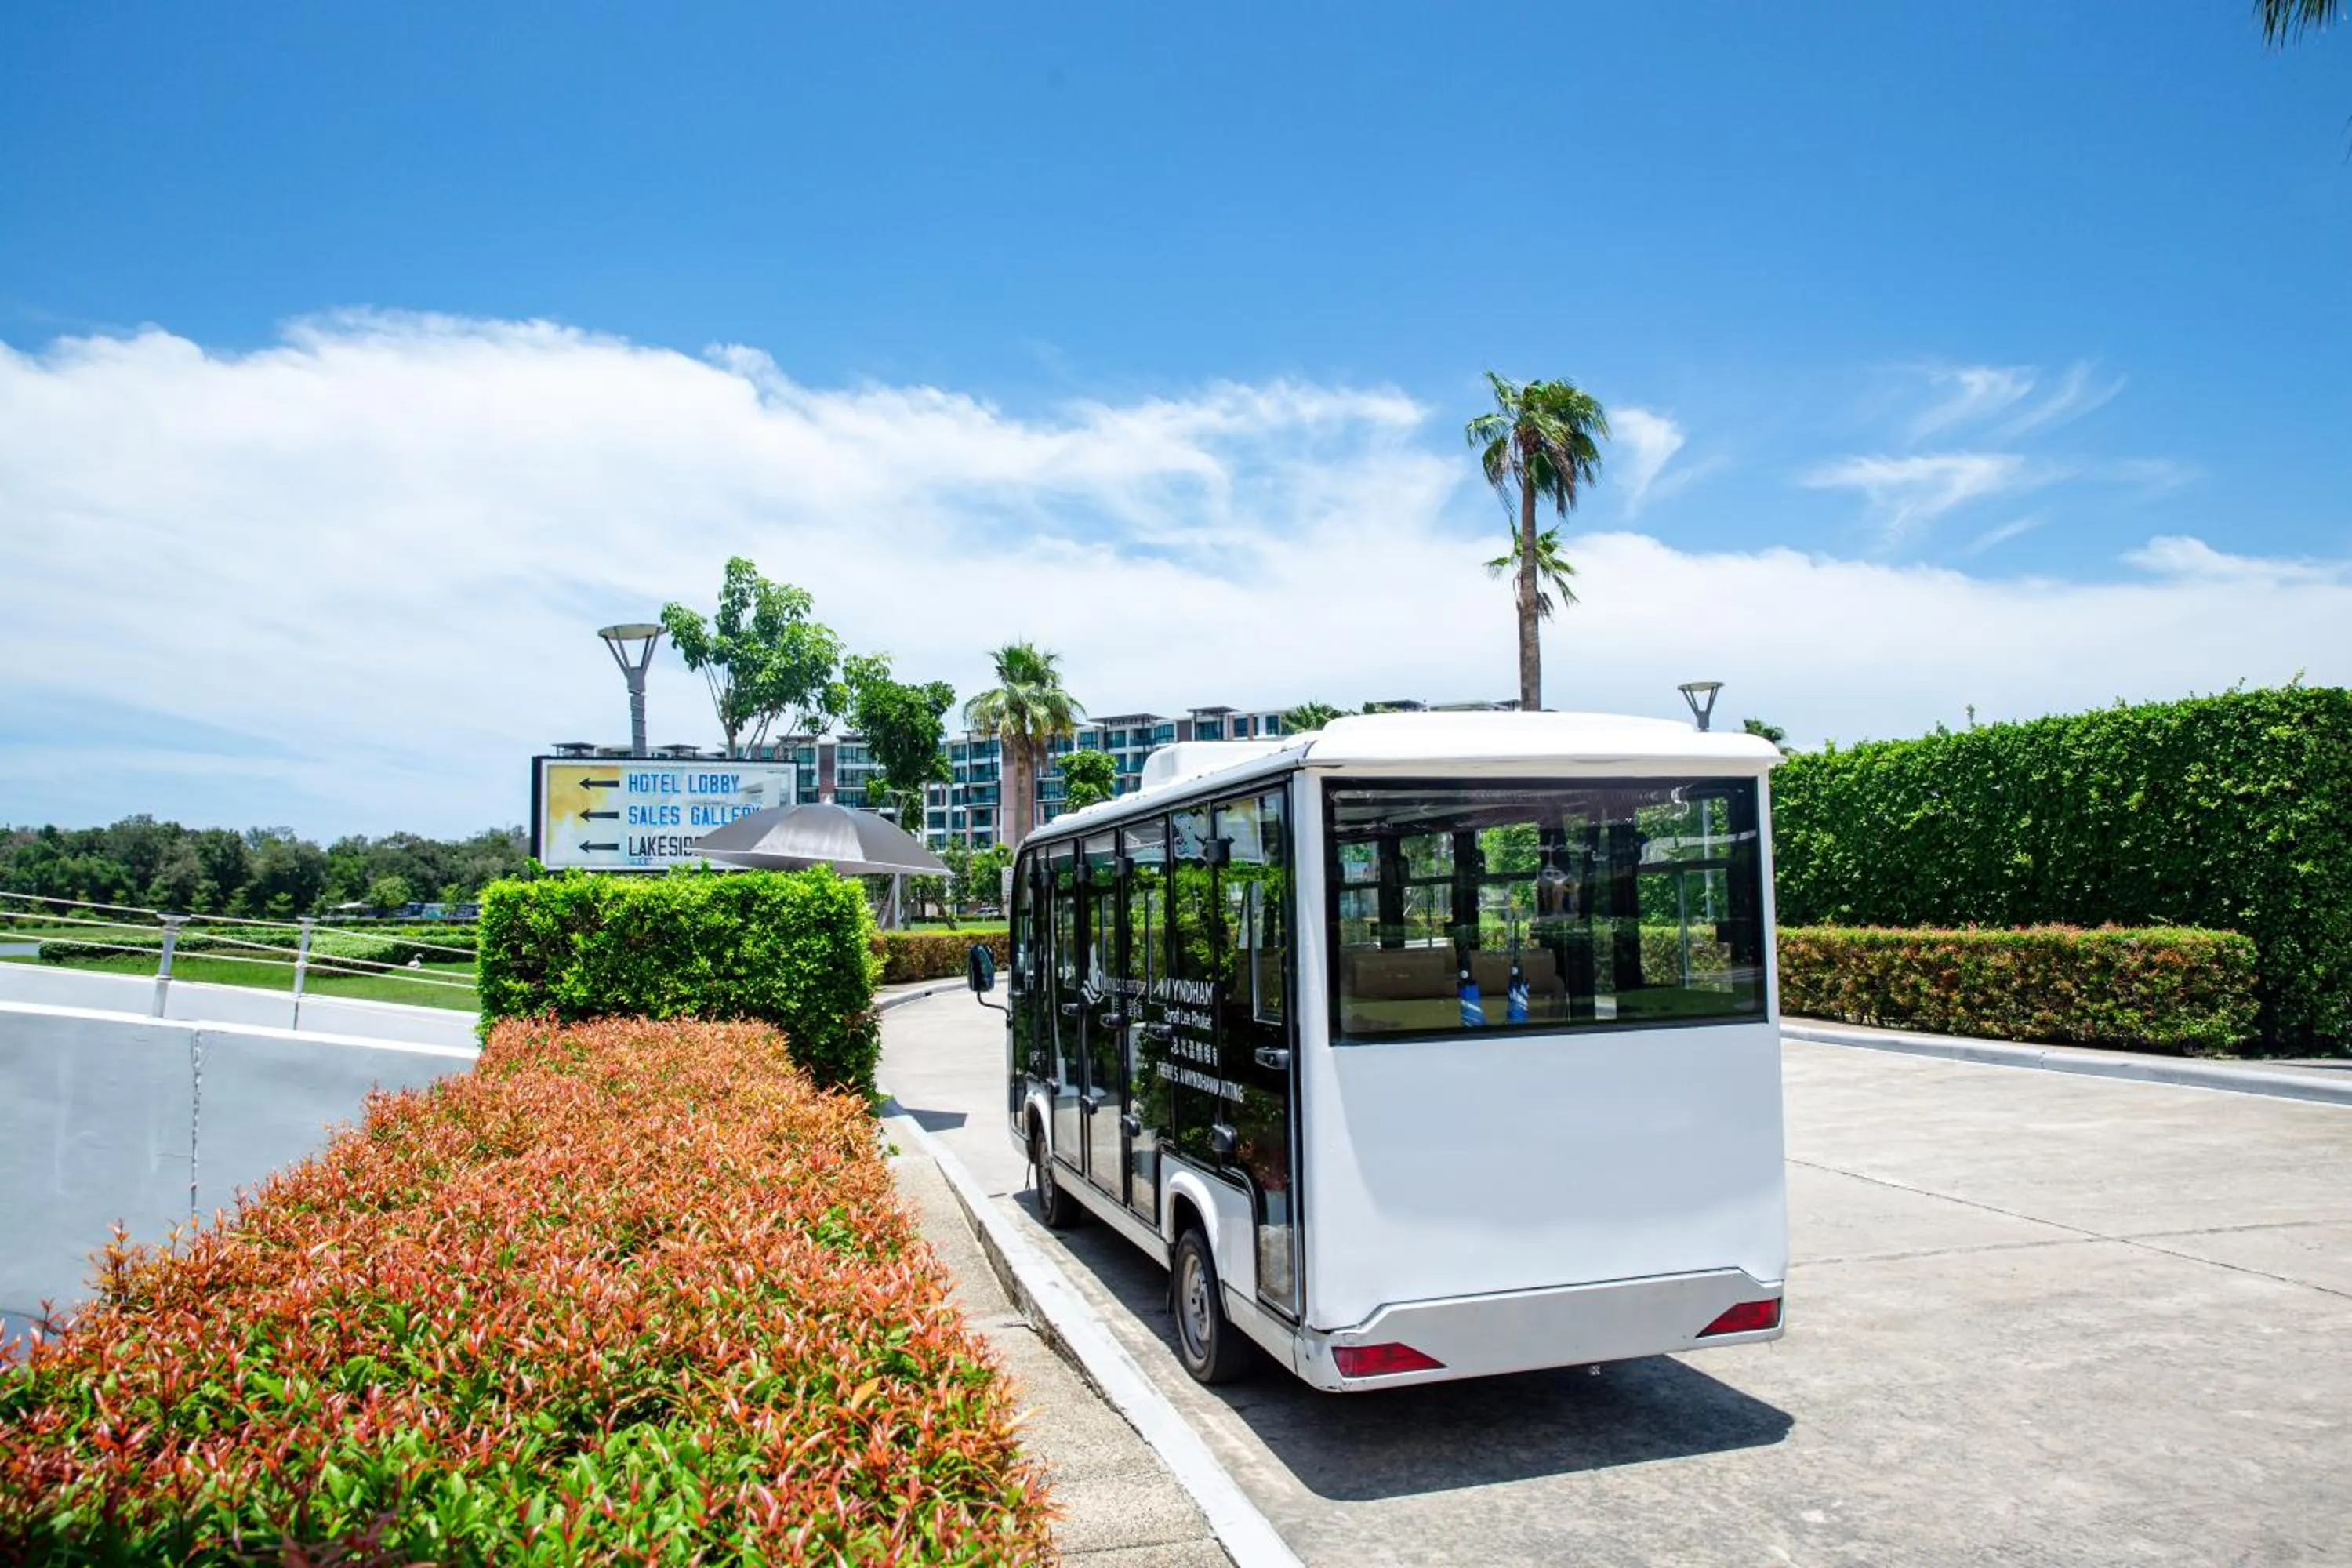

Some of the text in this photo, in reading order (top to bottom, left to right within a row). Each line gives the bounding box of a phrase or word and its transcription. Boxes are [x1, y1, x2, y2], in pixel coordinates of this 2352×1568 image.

[628, 774, 739, 793] HOTEL LOBBY
[628, 806, 760, 826] SALES GALLER
[1154, 978, 1214, 1005] WYNDHAM
